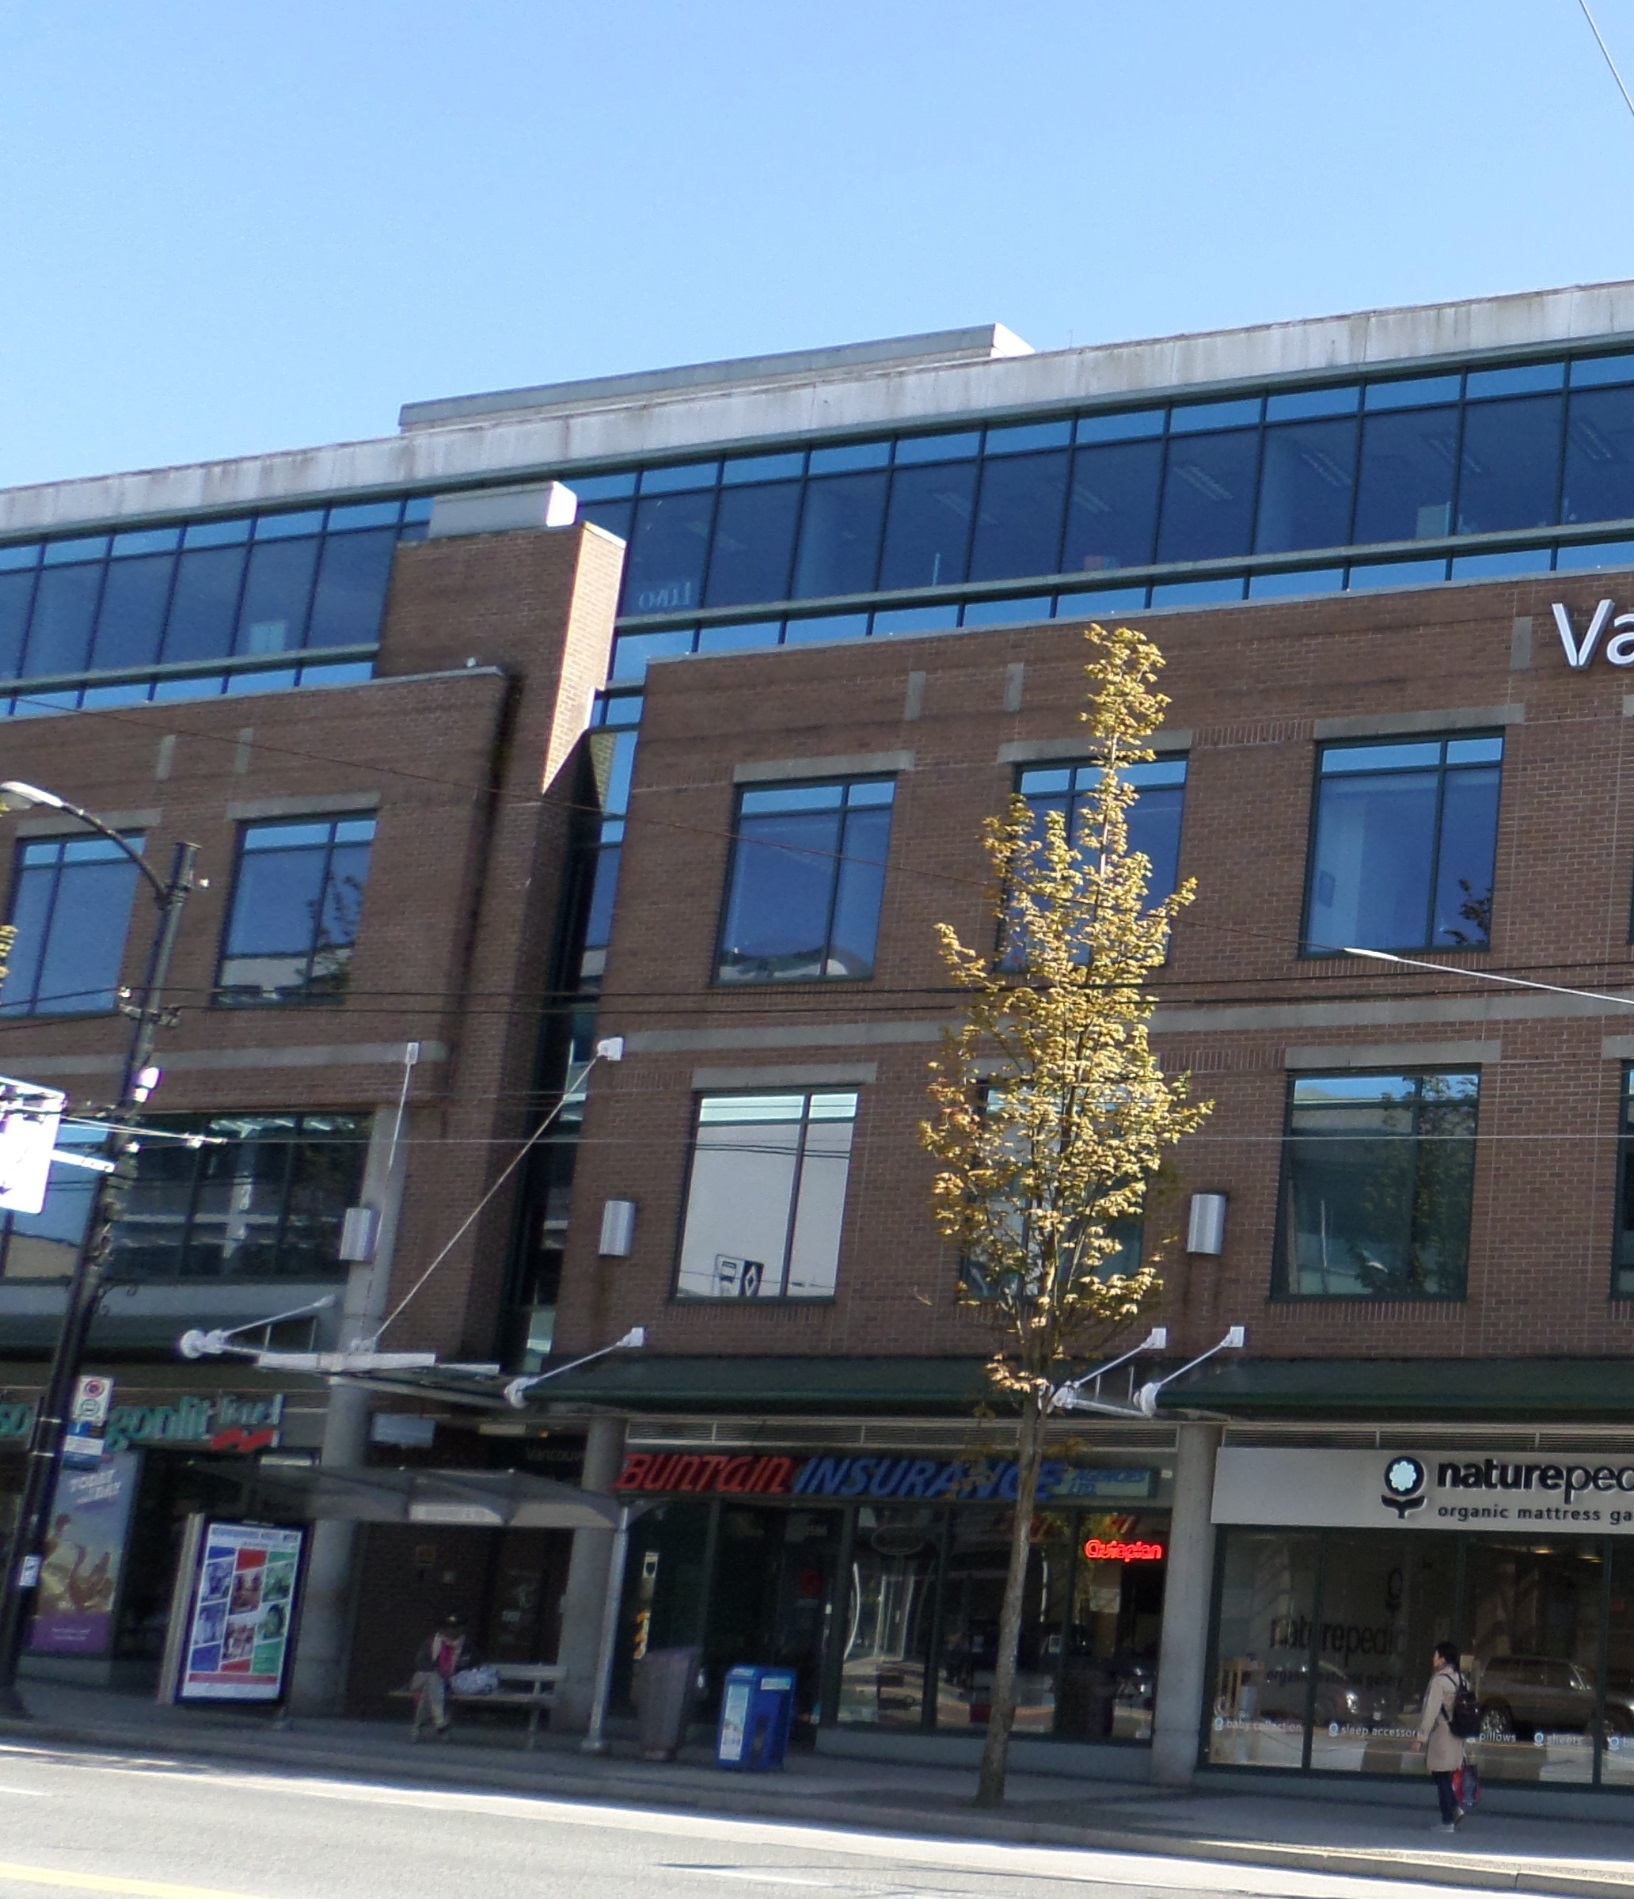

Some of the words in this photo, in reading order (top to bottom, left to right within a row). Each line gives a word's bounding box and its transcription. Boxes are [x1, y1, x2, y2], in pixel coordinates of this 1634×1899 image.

[1438, 1504, 1509, 1521] organic
[1517, 1507, 1601, 1521] mattress
[1340, 1724, 1369, 1738] sleep
[1479, 1732, 1517, 1744] pillows
